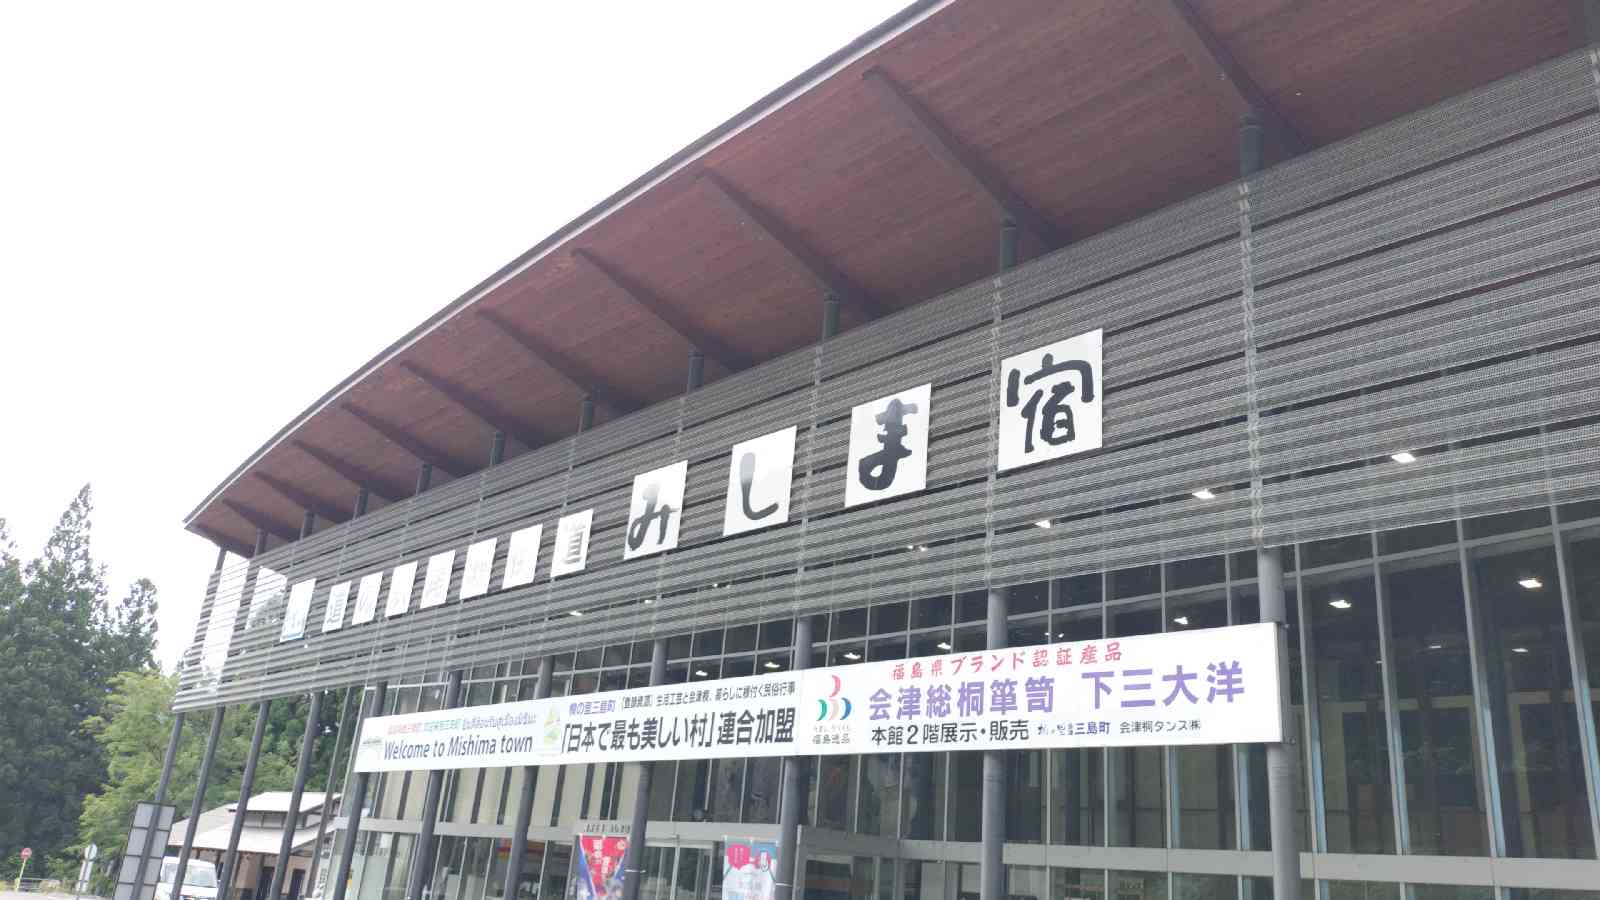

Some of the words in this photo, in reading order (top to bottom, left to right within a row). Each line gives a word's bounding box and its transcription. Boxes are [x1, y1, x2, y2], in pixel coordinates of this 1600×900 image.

[892, 641, 1122, 681] 福島県ブランド認証産品
[1081, 660, 1245, 710] 下三大洋
[383, 740, 430, 760] Welcome
[433, 740, 445, 757] to
[446, 734, 497, 756] Mishima
[500, 734, 533, 753] town
[562, 707, 797, 754] 「日本で最も美しい村」連合加盟
